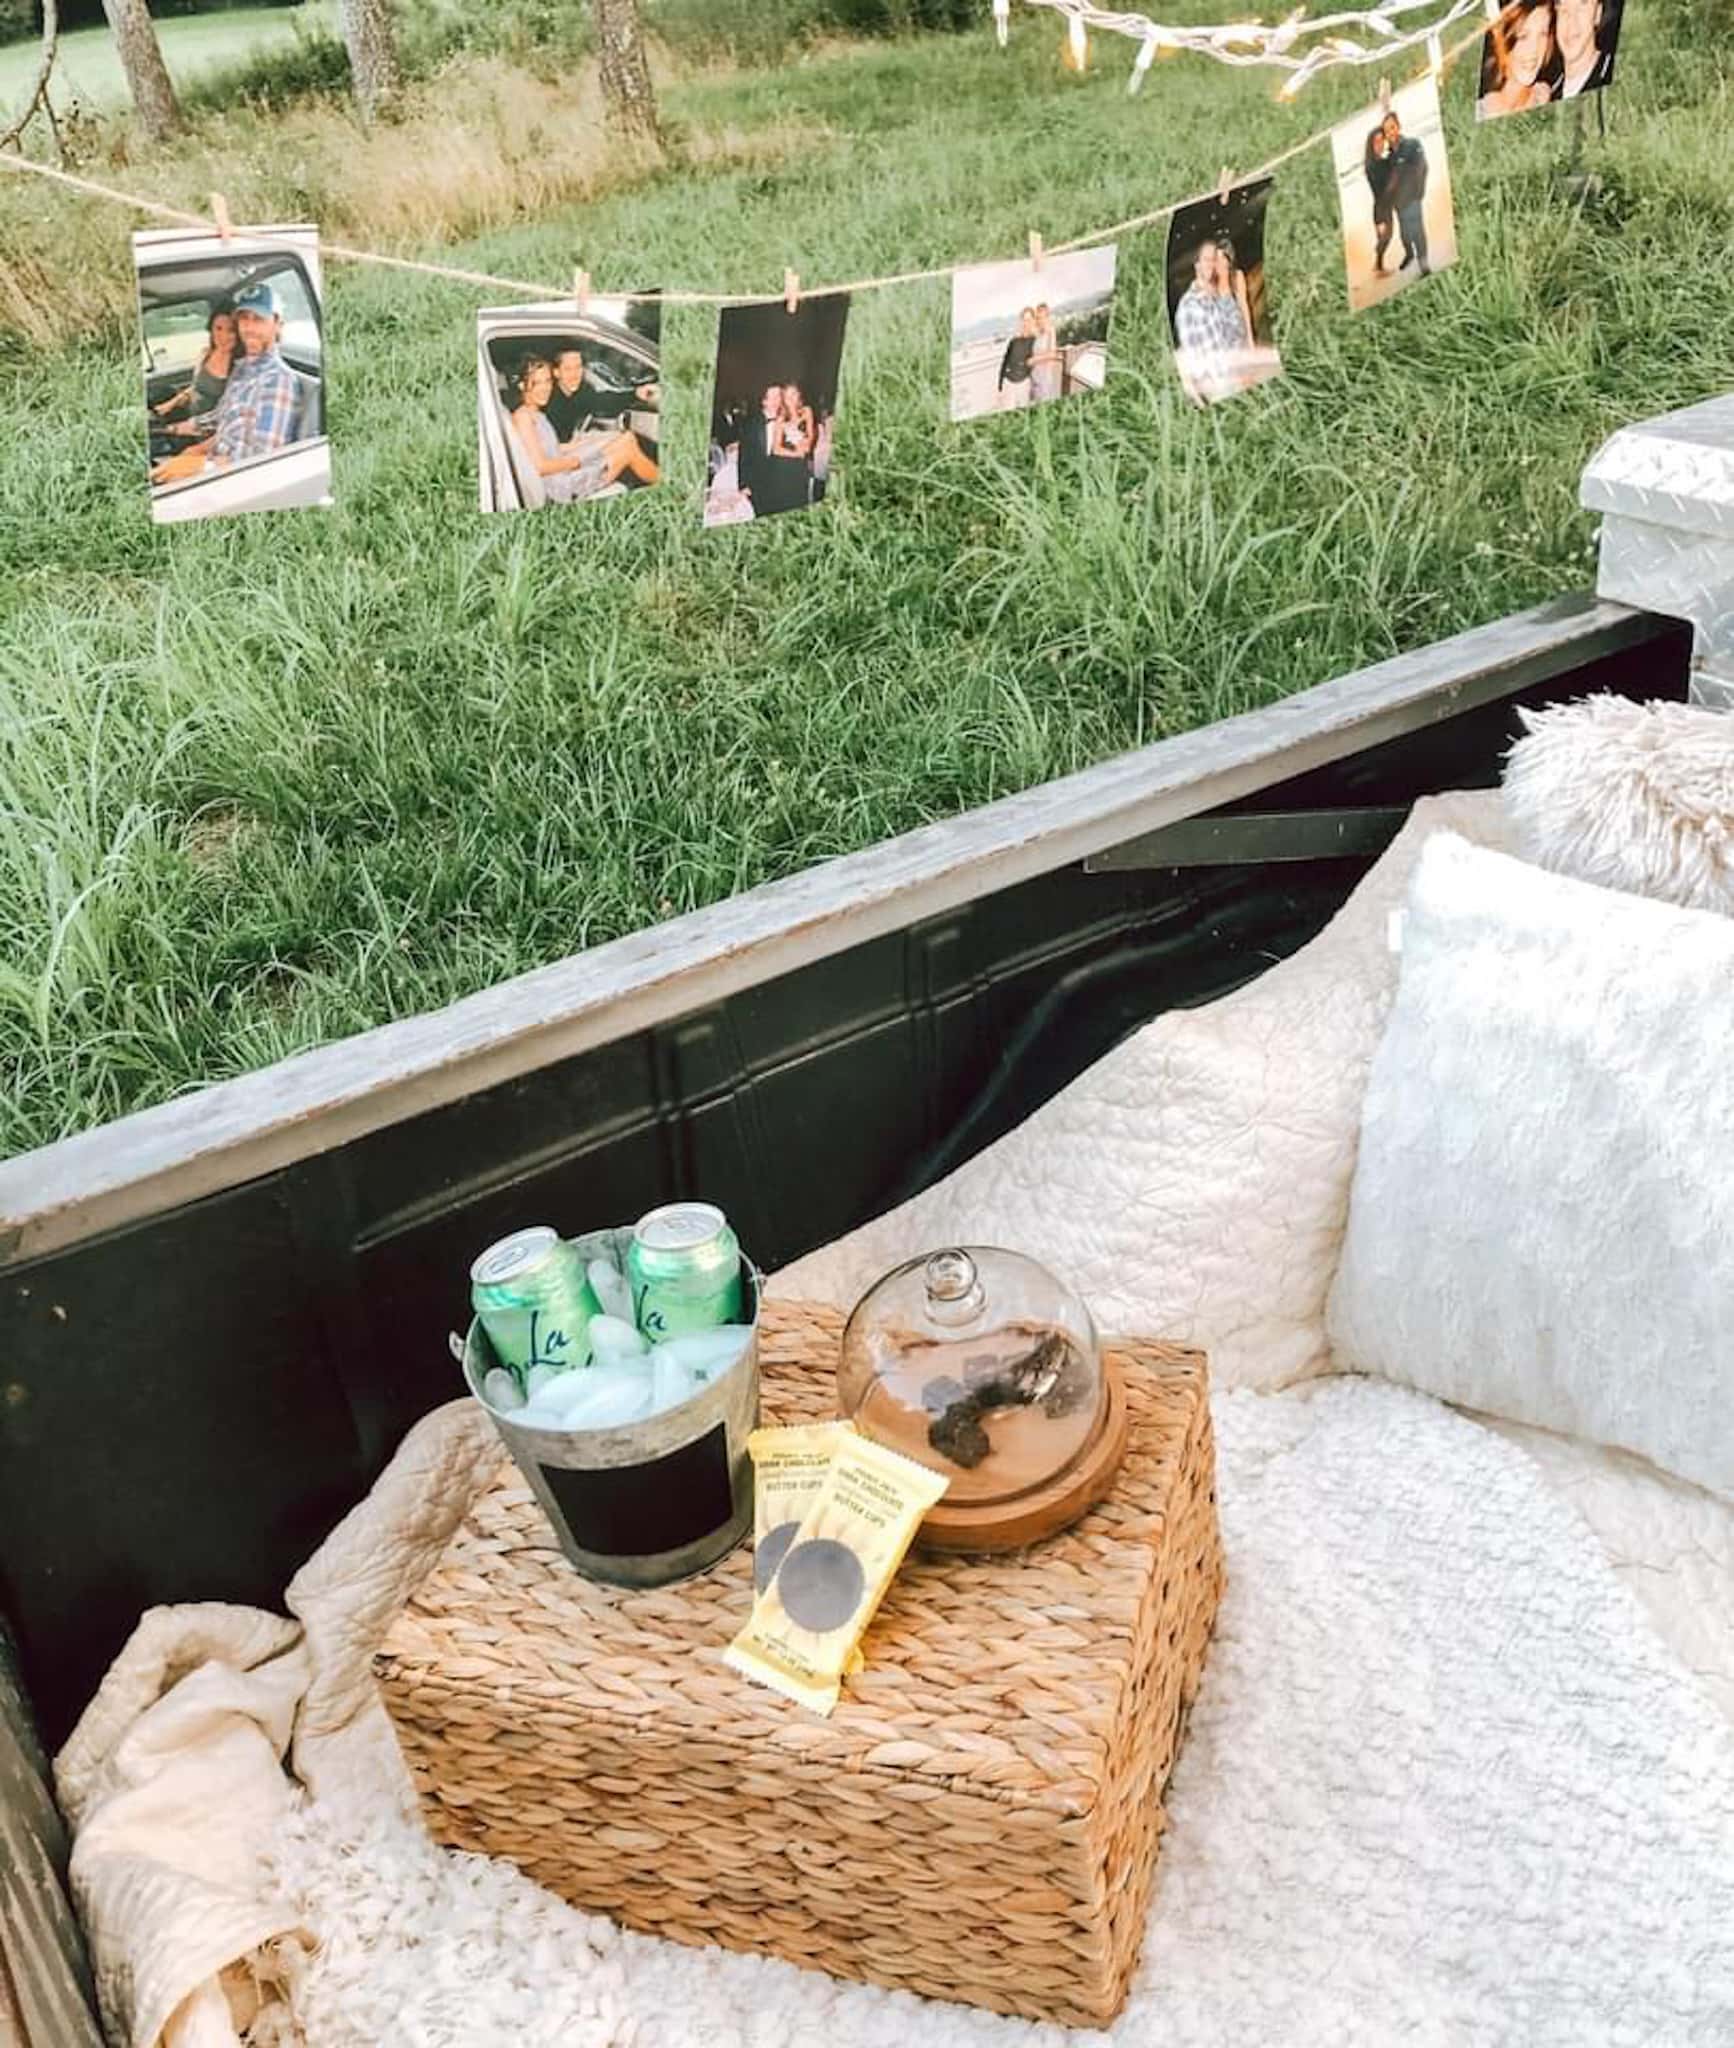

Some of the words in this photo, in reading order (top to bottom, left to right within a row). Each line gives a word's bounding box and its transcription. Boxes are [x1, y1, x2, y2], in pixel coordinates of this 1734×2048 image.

[530, 1310, 571, 1367] La
[800, 1480, 824, 1491] CUPS
[864, 1511, 887, 1529] CUPS
